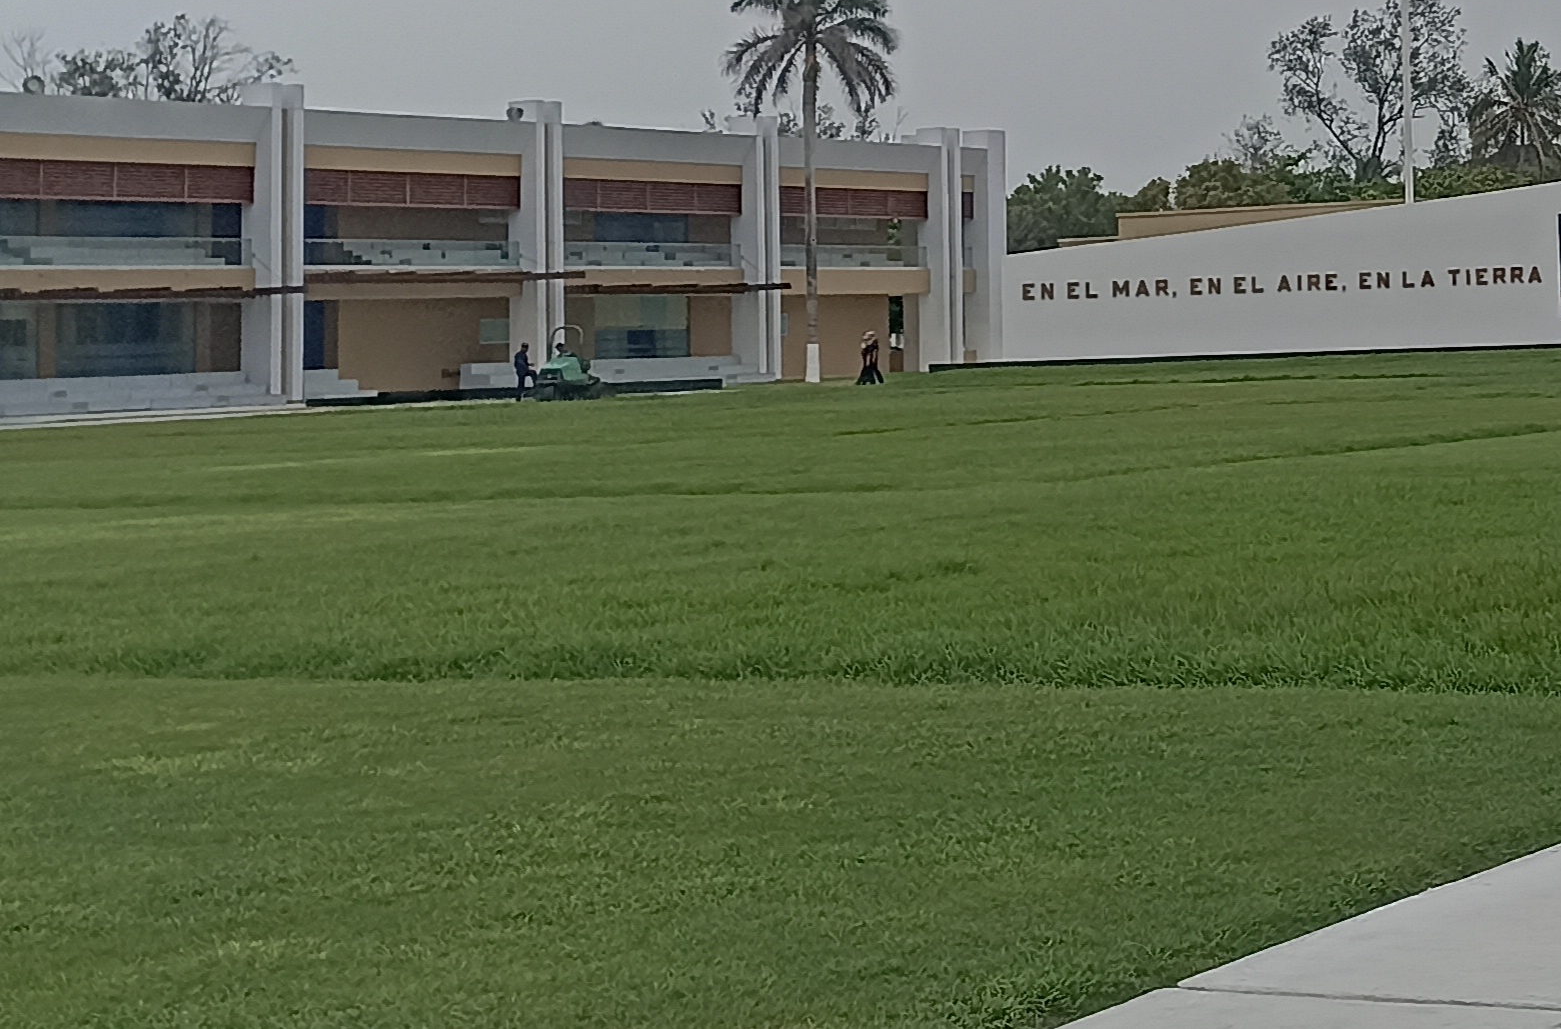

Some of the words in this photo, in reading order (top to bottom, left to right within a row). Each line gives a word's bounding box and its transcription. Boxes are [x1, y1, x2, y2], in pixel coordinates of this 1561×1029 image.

[1021, 282, 1055, 302] EN
[1066, 281, 1099, 300] EL
[1111, 278, 1178, 299] MAR,
[1189, 277, 1222, 296] EN
[1233, 275, 1265, 295] EL
[1276, 273, 1347, 293] AIRE,
[1358, 271, 1391, 290] EN
[1401, 269, 1436, 289] LA
[1446, 265, 1543, 287] TIERRA
